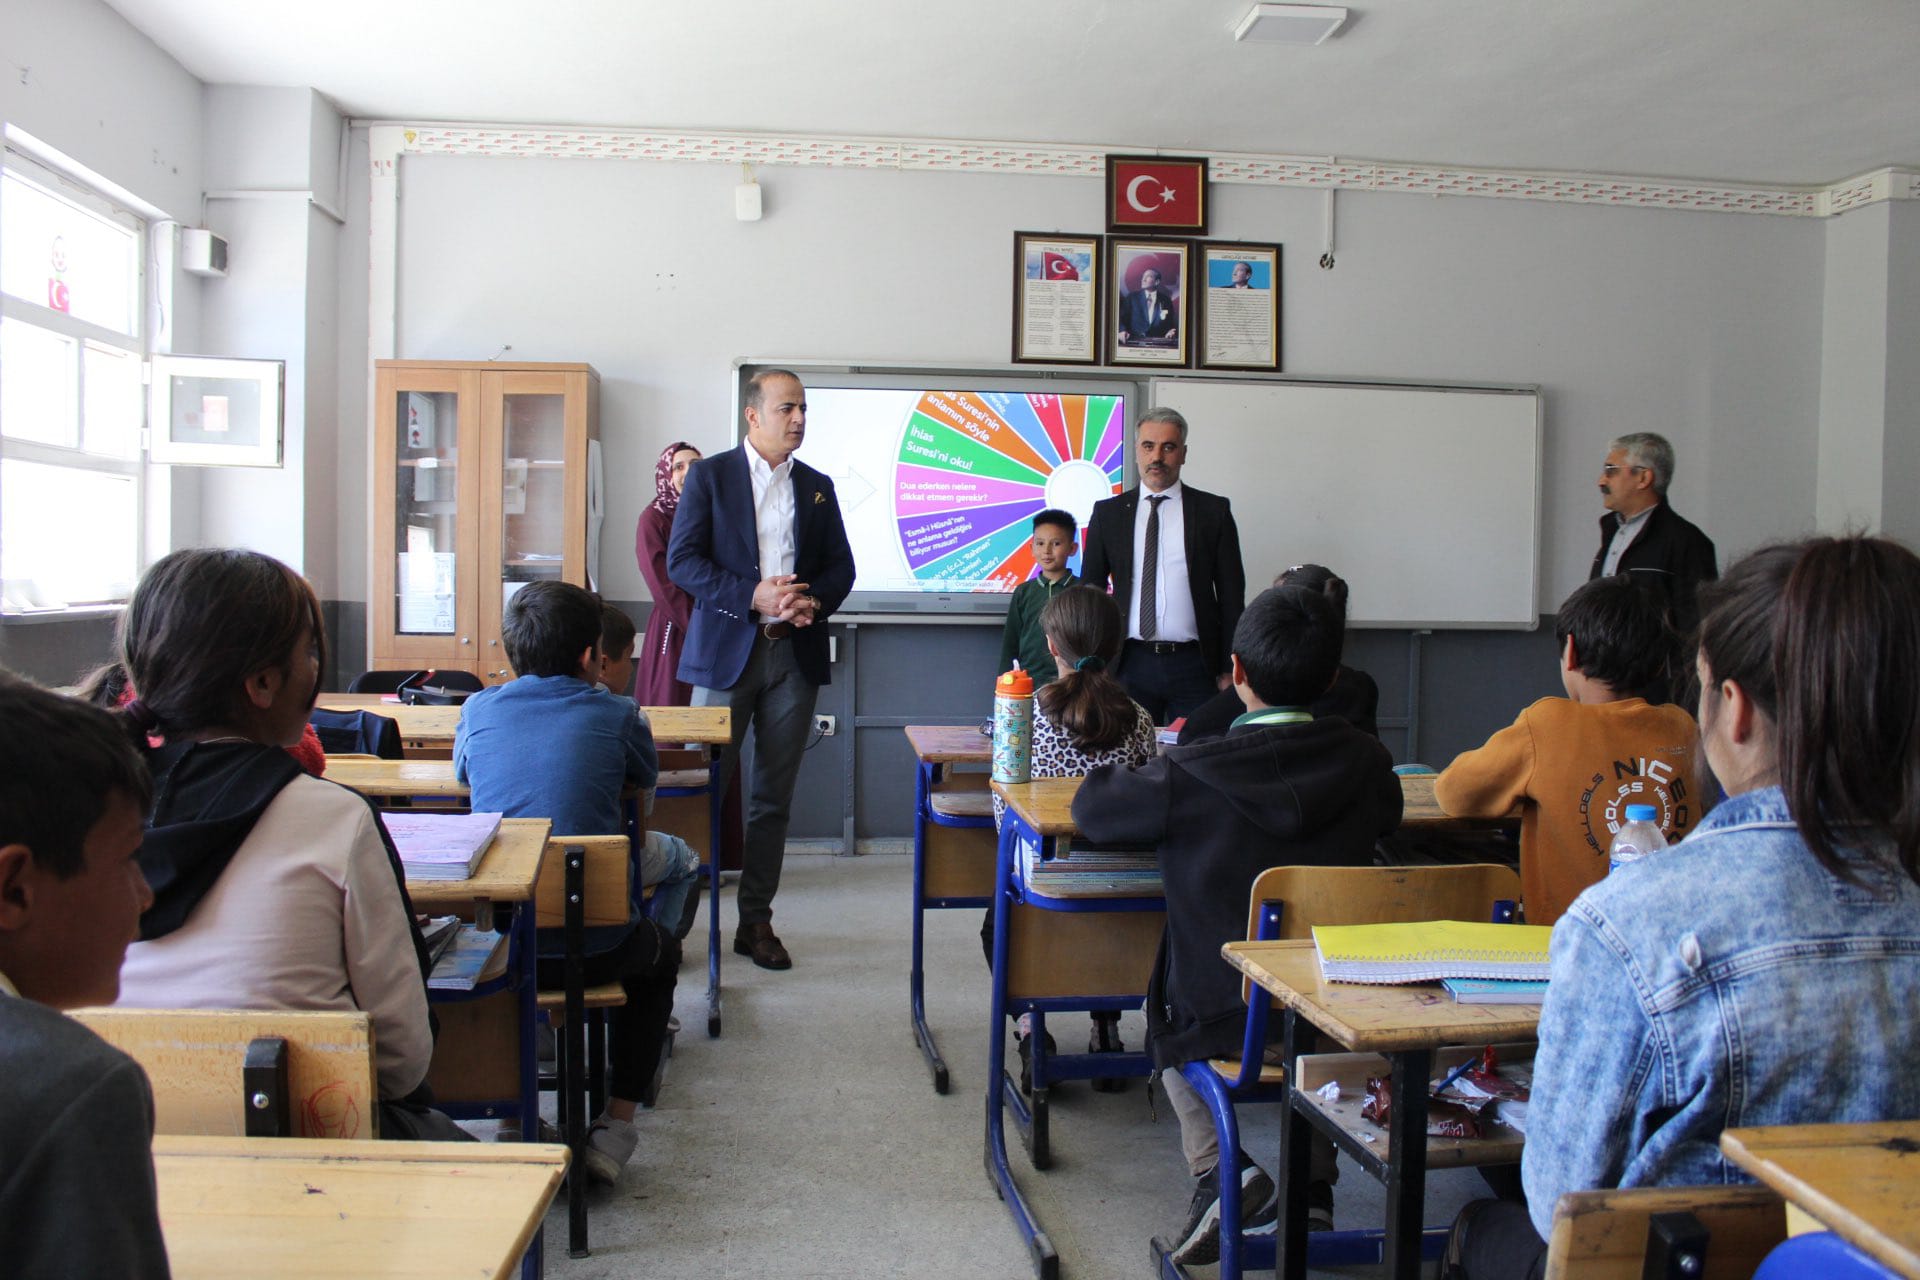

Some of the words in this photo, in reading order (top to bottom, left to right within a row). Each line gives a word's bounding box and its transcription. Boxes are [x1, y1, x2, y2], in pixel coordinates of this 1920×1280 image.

[927, 395, 965, 424] anlamını
[965, 421, 990, 442] söyle
[957, 397, 1001, 432] Suresi'nin
[906, 440, 949, 462] Suresi'ni
[949, 456, 974, 471] oku!
[900, 482, 916, 490] Dua
